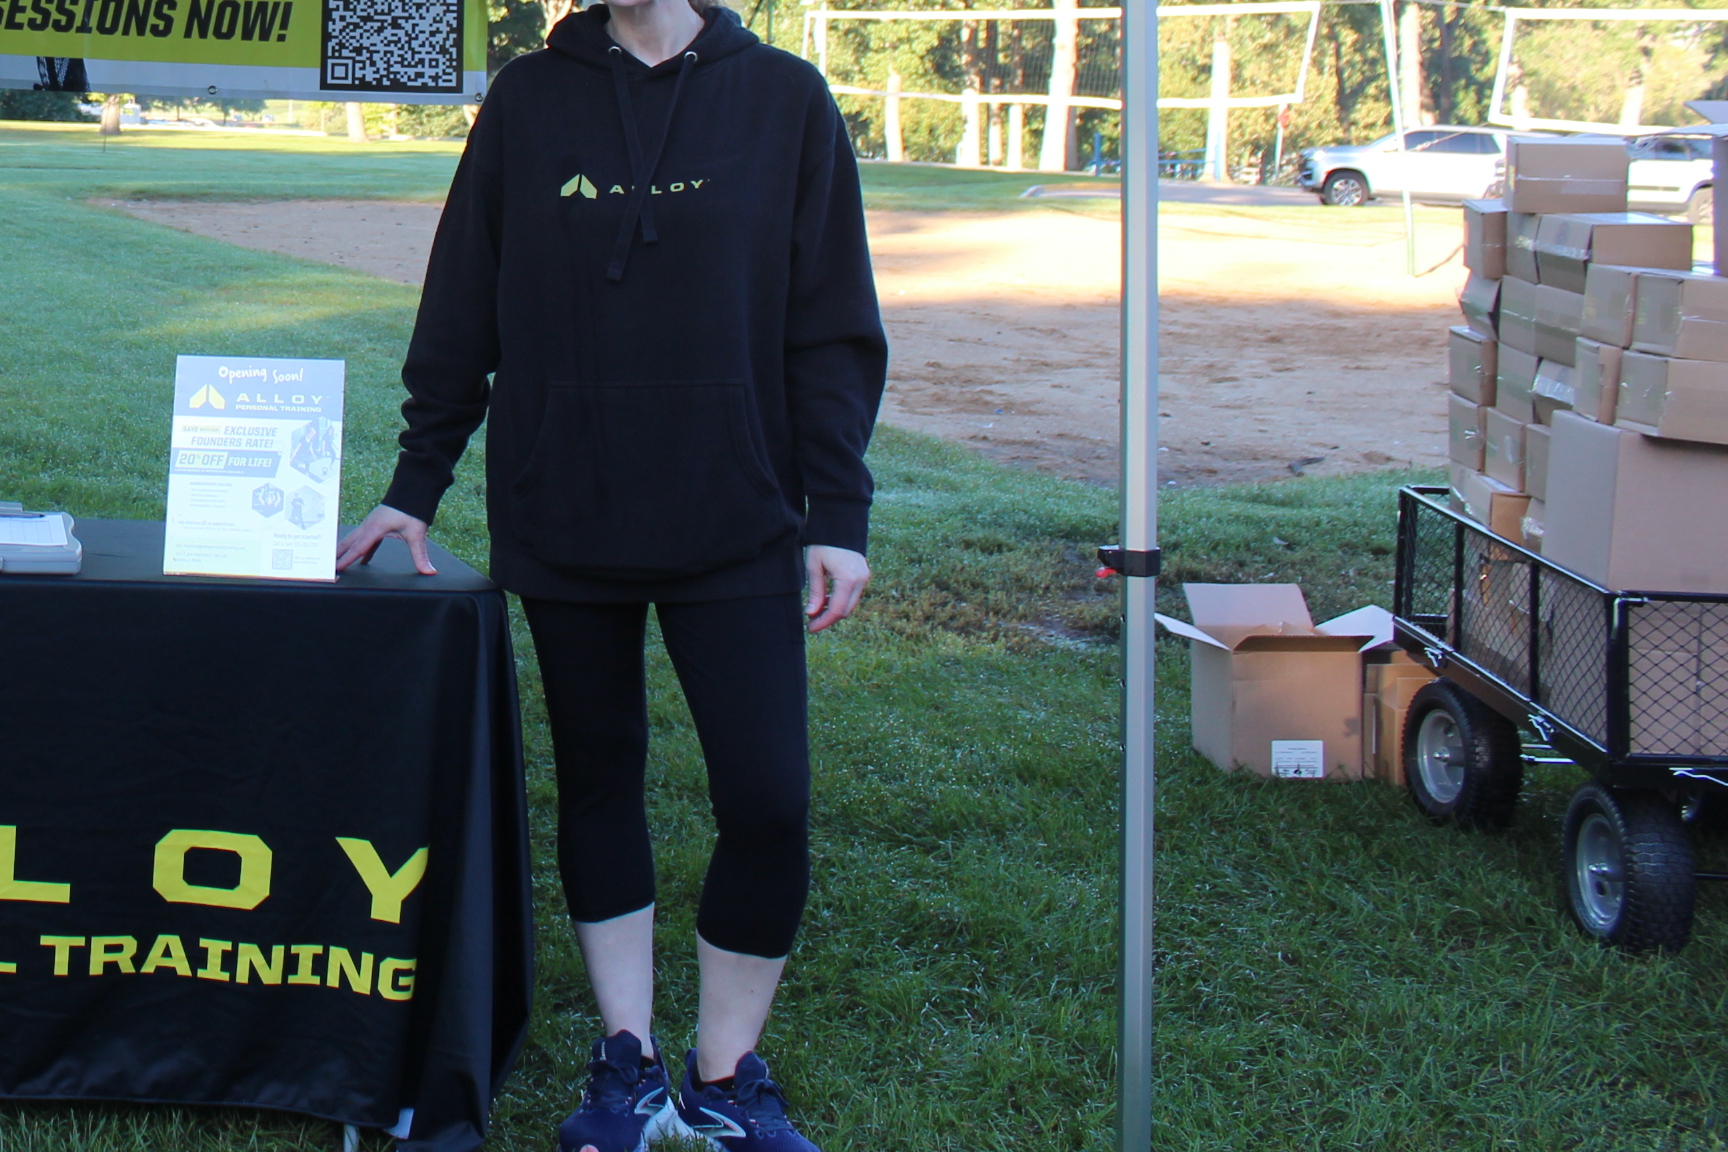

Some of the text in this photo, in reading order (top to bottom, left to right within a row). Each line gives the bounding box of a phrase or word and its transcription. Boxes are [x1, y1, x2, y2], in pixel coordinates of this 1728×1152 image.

[609, 179, 704, 194] ALOY
[218, 365, 304, 384] Opening Soon!
[236, 393, 323, 404] ALLOY
[224, 426, 278, 437] EXCLUSIVE
[191, 436, 274, 448] FOUNDERS RATE!
[202, 454, 225, 466] OFF
[228, 456, 247, 467] FOR
[248, 457, 273, 467] LIFE!
[41, 934, 418, 1002] TRAINING
